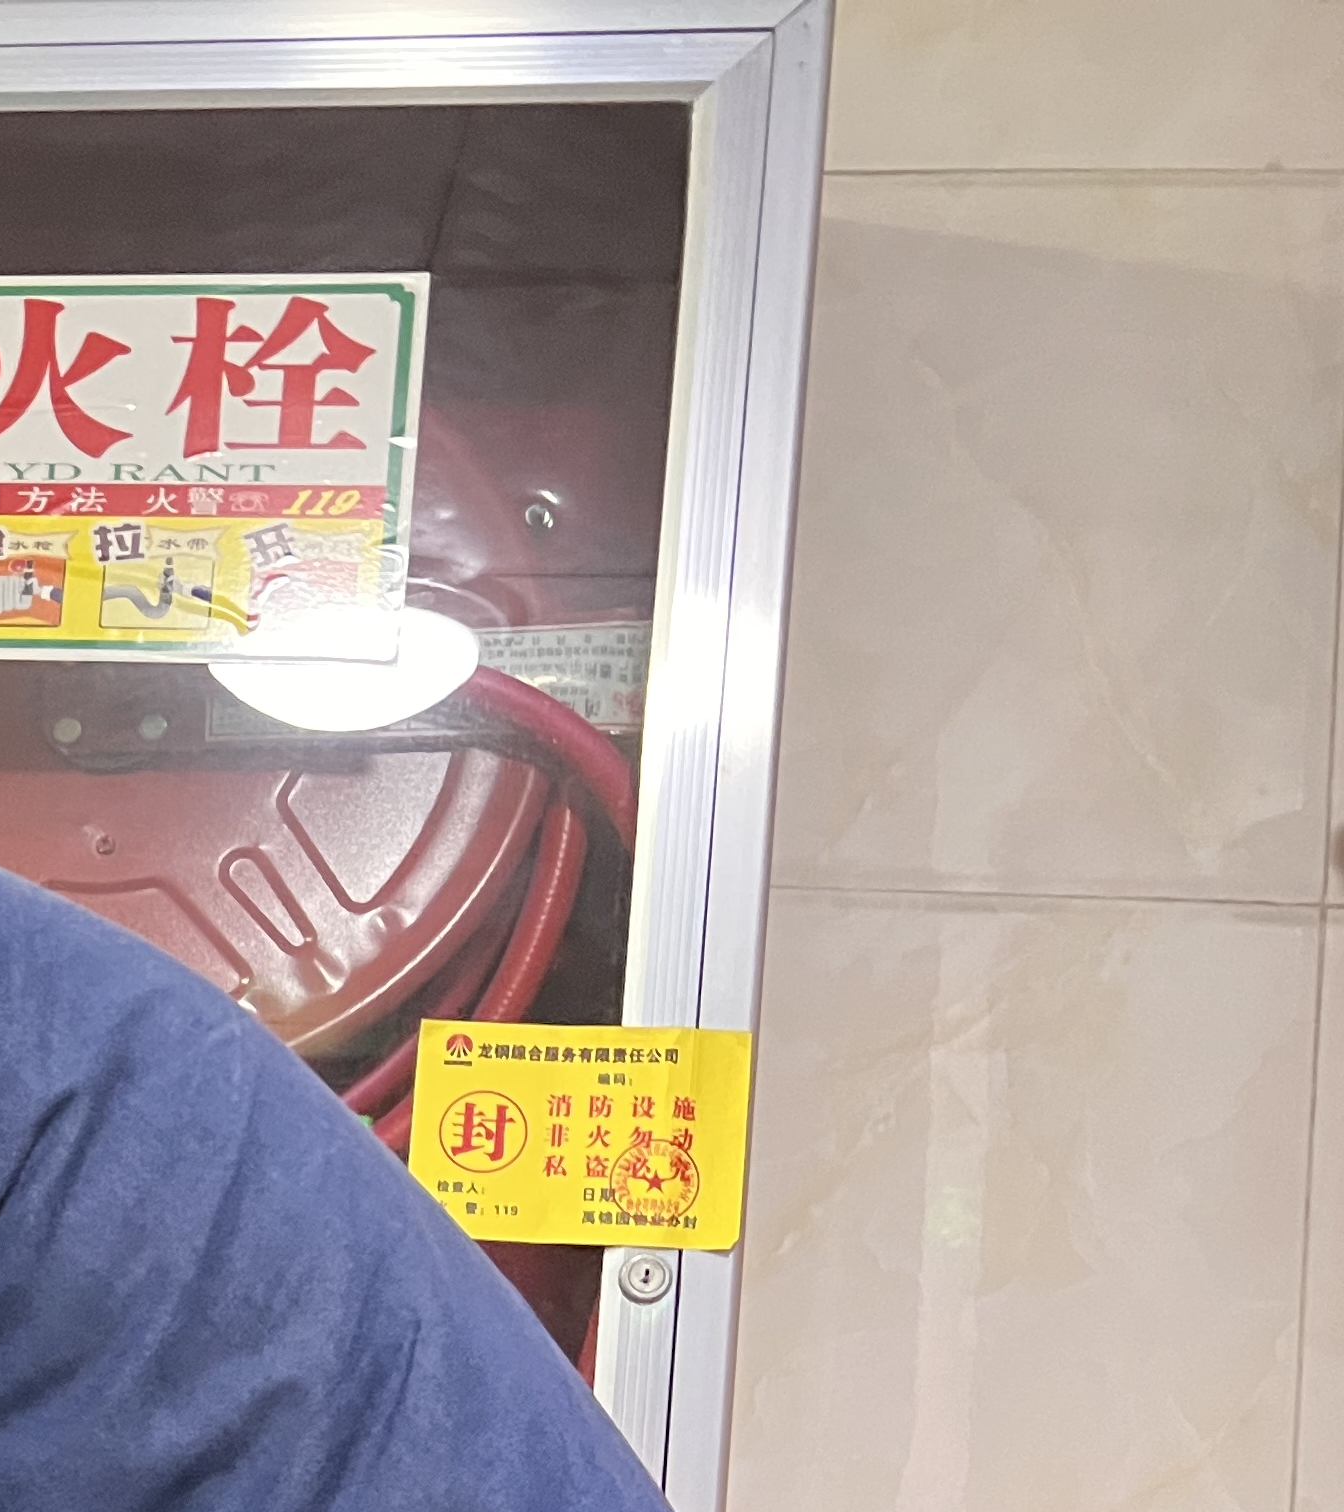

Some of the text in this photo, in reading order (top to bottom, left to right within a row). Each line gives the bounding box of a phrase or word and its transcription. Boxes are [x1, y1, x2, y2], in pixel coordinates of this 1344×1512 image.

[109, 462, 276, 483] RANT
[143, 486, 224, 516] 火警
[282, 488, 362, 516] 119
[93, 524, 145, 562] 拉
[546, 1094, 696, 1122] 消防设施
[451, 1101, 516, 1162] 封
[544, 1124, 694, 1152] 非火勿动
